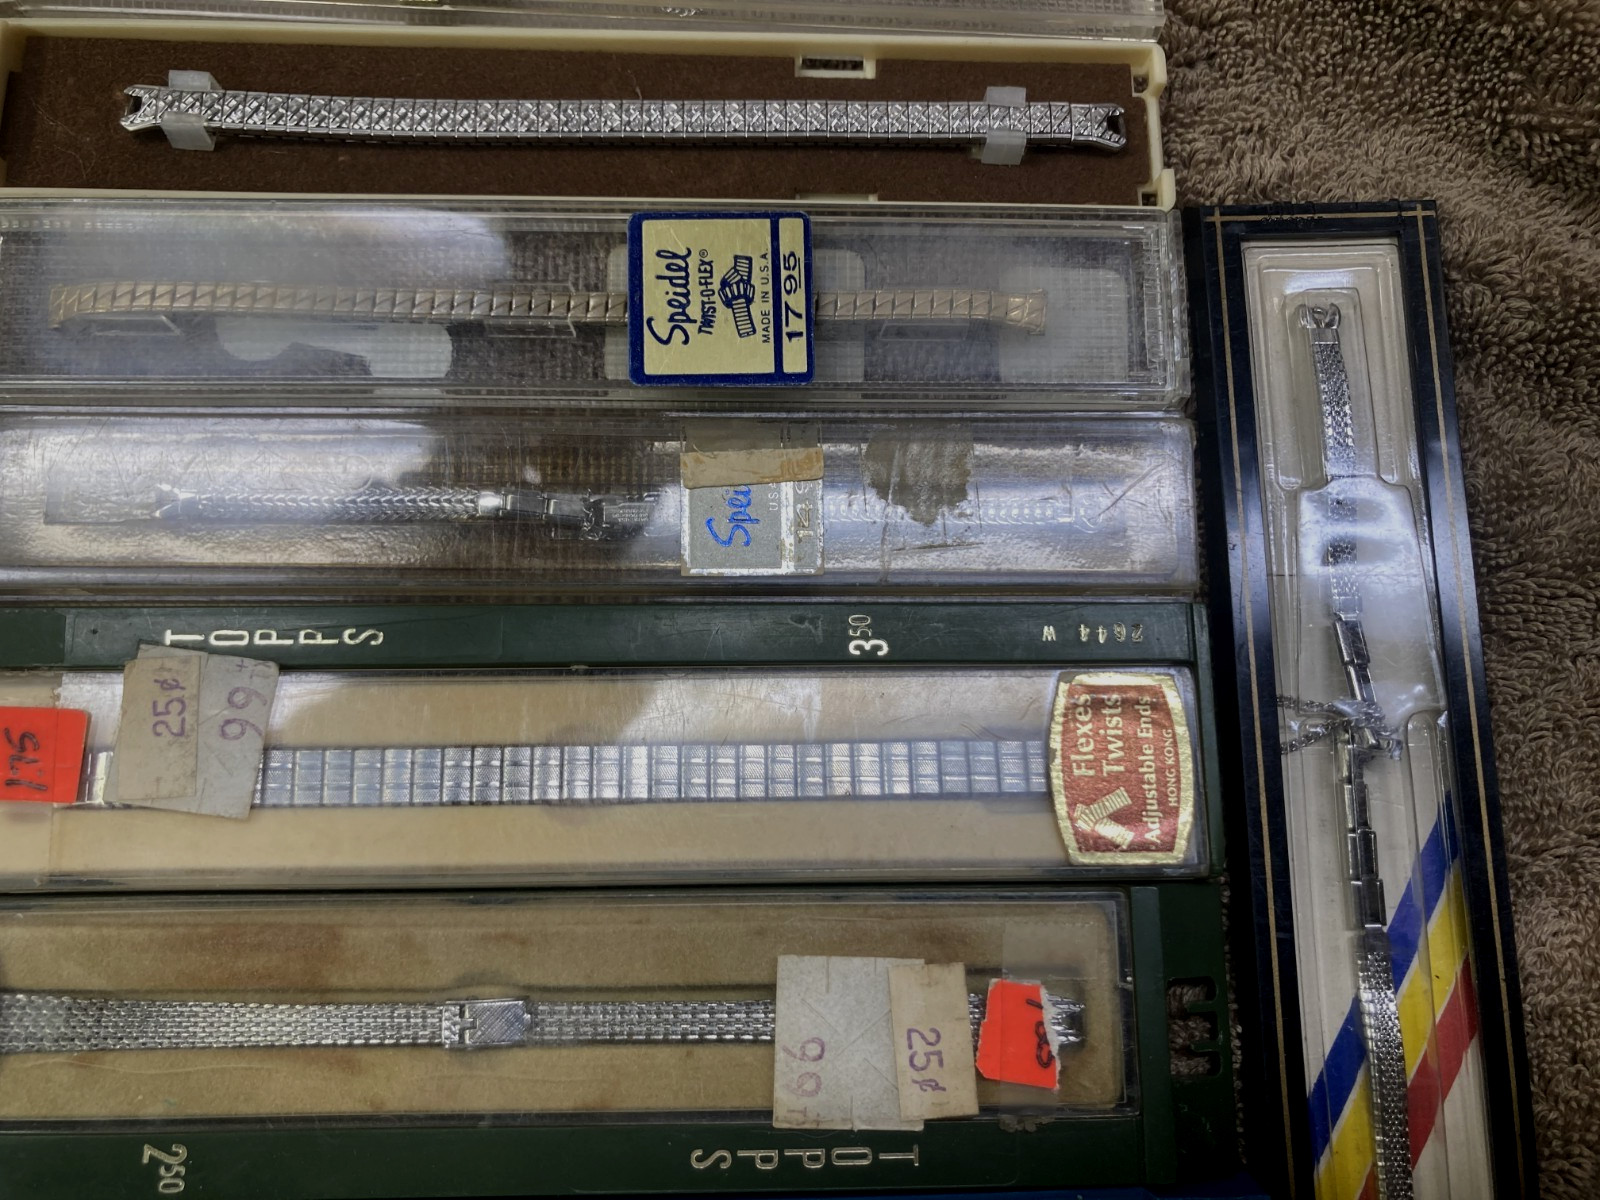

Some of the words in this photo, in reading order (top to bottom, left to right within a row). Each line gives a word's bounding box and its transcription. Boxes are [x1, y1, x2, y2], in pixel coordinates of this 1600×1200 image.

[759, 248, 770, 286] U.S.A.
[646, 247, 697, 346] Speidel
[761, 290, 770, 303] IN
[762, 309, 771, 344] MADE
[706, 484, 760, 547] Spei
[164, 628, 384, 646] TOPPS
[152, 678, 186, 738] 25¢
[1070, 693, 1096, 778] Flexes
[1099, 693, 1125, 778] Twists
[1162, 728, 1174, 765] KONG
[1138, 743, 1163, 844] Adjustable
[1165, 769, 1178, 807] HONG
[906, 1027, 947, 1092] 25¢
[690, 1144, 920, 1170] TOPPS
